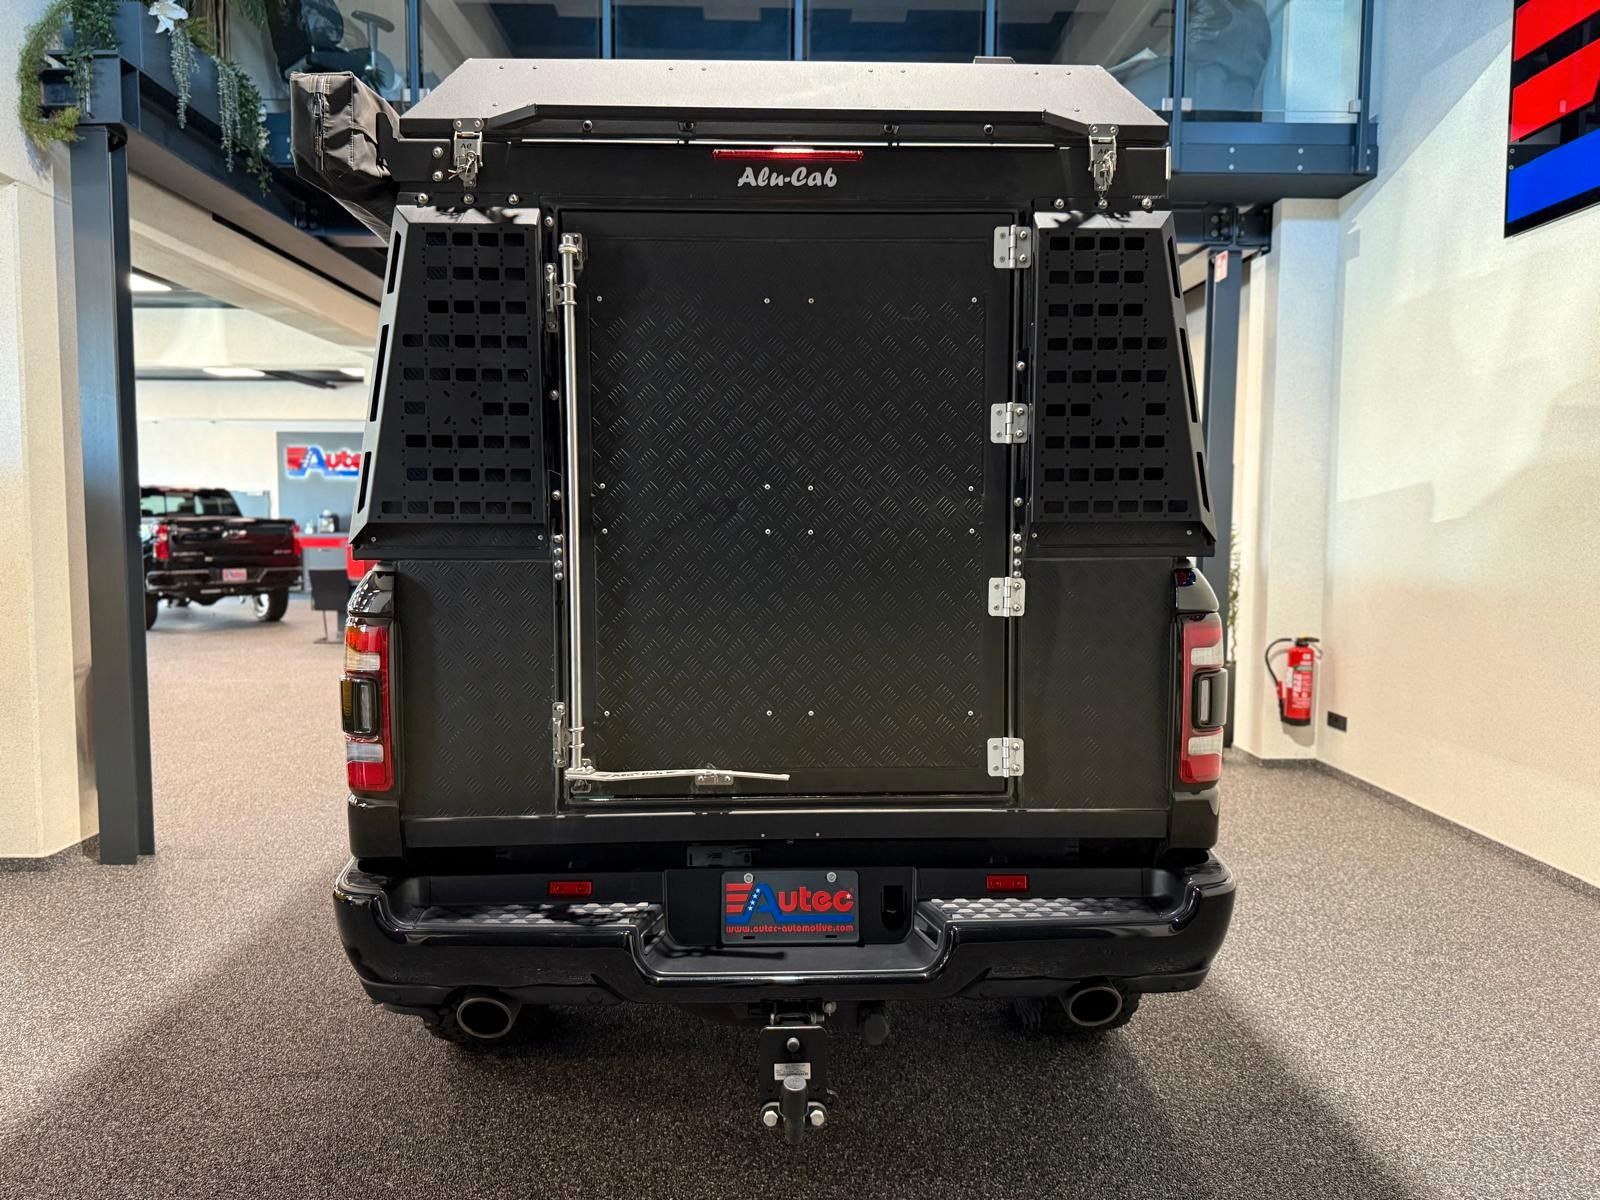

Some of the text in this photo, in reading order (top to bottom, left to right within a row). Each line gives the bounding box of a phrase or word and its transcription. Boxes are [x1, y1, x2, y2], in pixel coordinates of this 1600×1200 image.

[737, 166, 838, 188] Alu-Cab
[736, 882, 855, 922] Autec
[726, 923, 854, 934] www.autec-automotive.com
